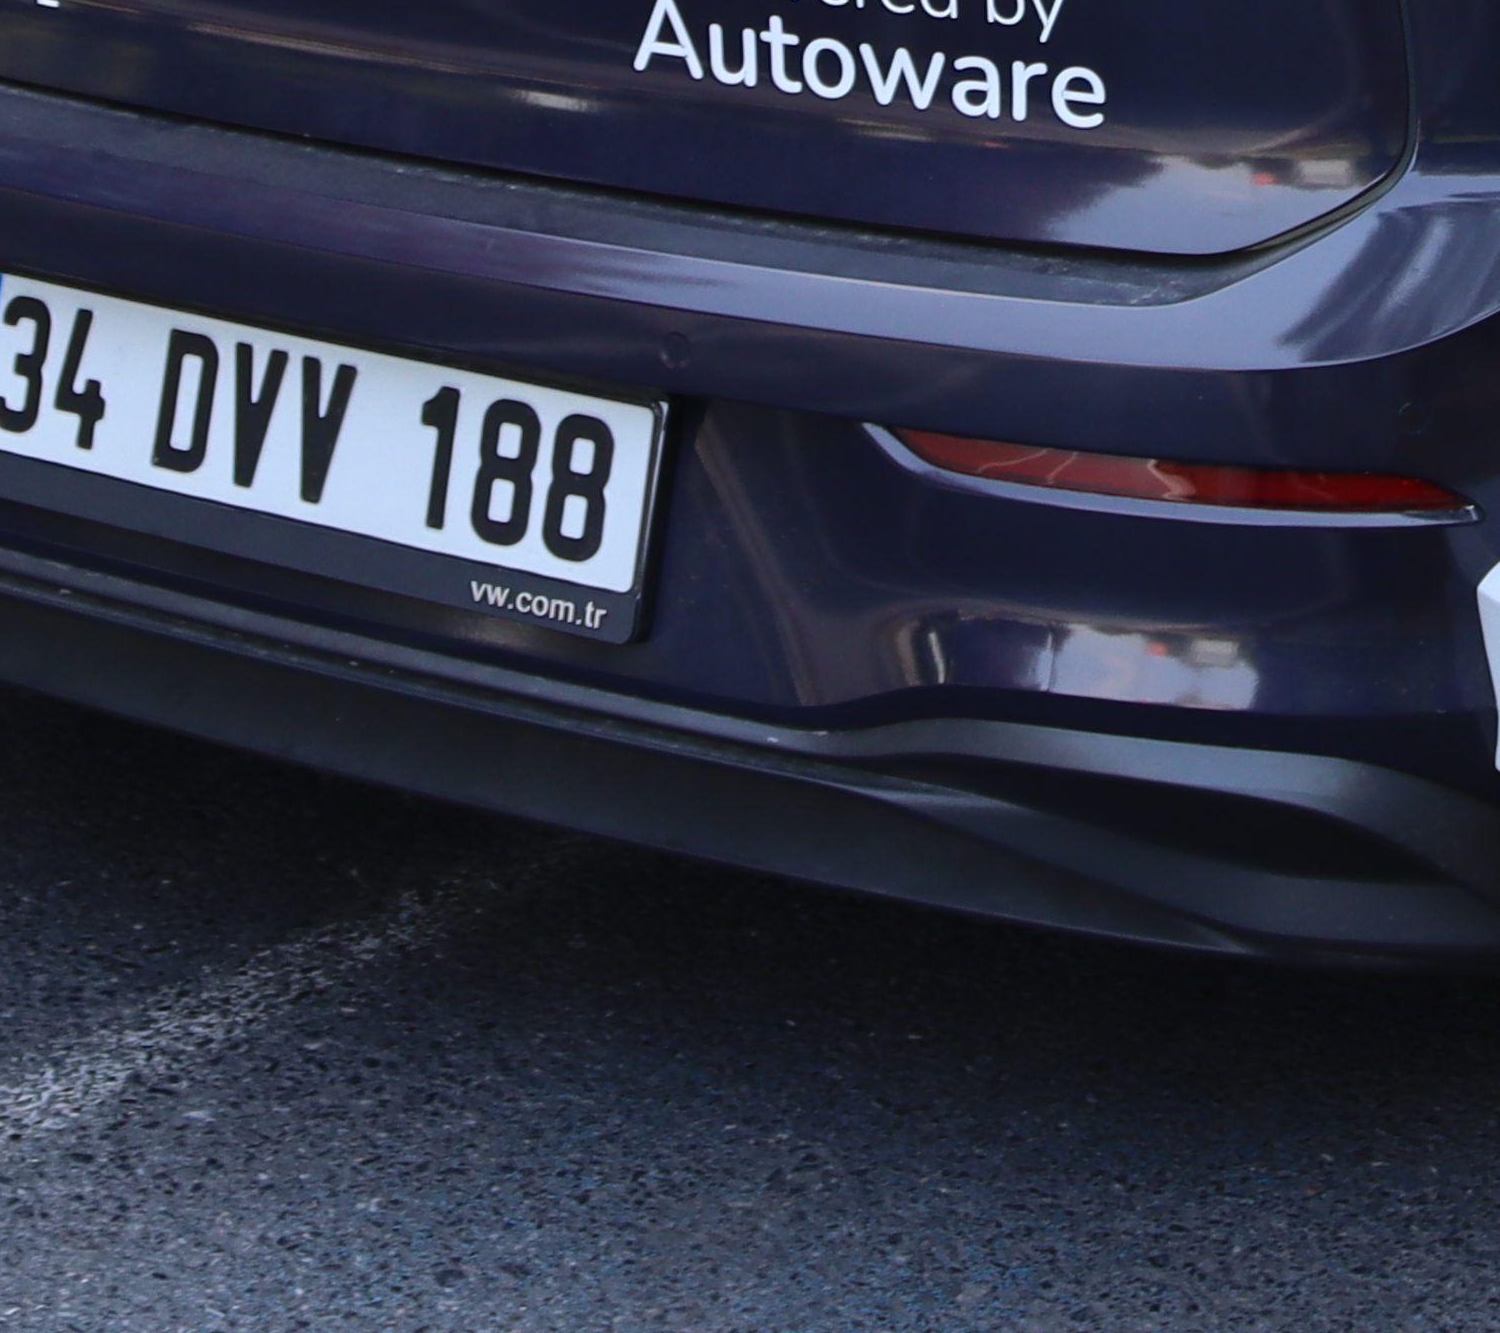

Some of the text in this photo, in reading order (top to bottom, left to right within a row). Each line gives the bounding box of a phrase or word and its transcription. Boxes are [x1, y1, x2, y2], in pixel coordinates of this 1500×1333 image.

[151, 328, 359, 505] DVV
[419, 384, 616, 563] 188
[469, 579, 608, 630] vw.com.tr
